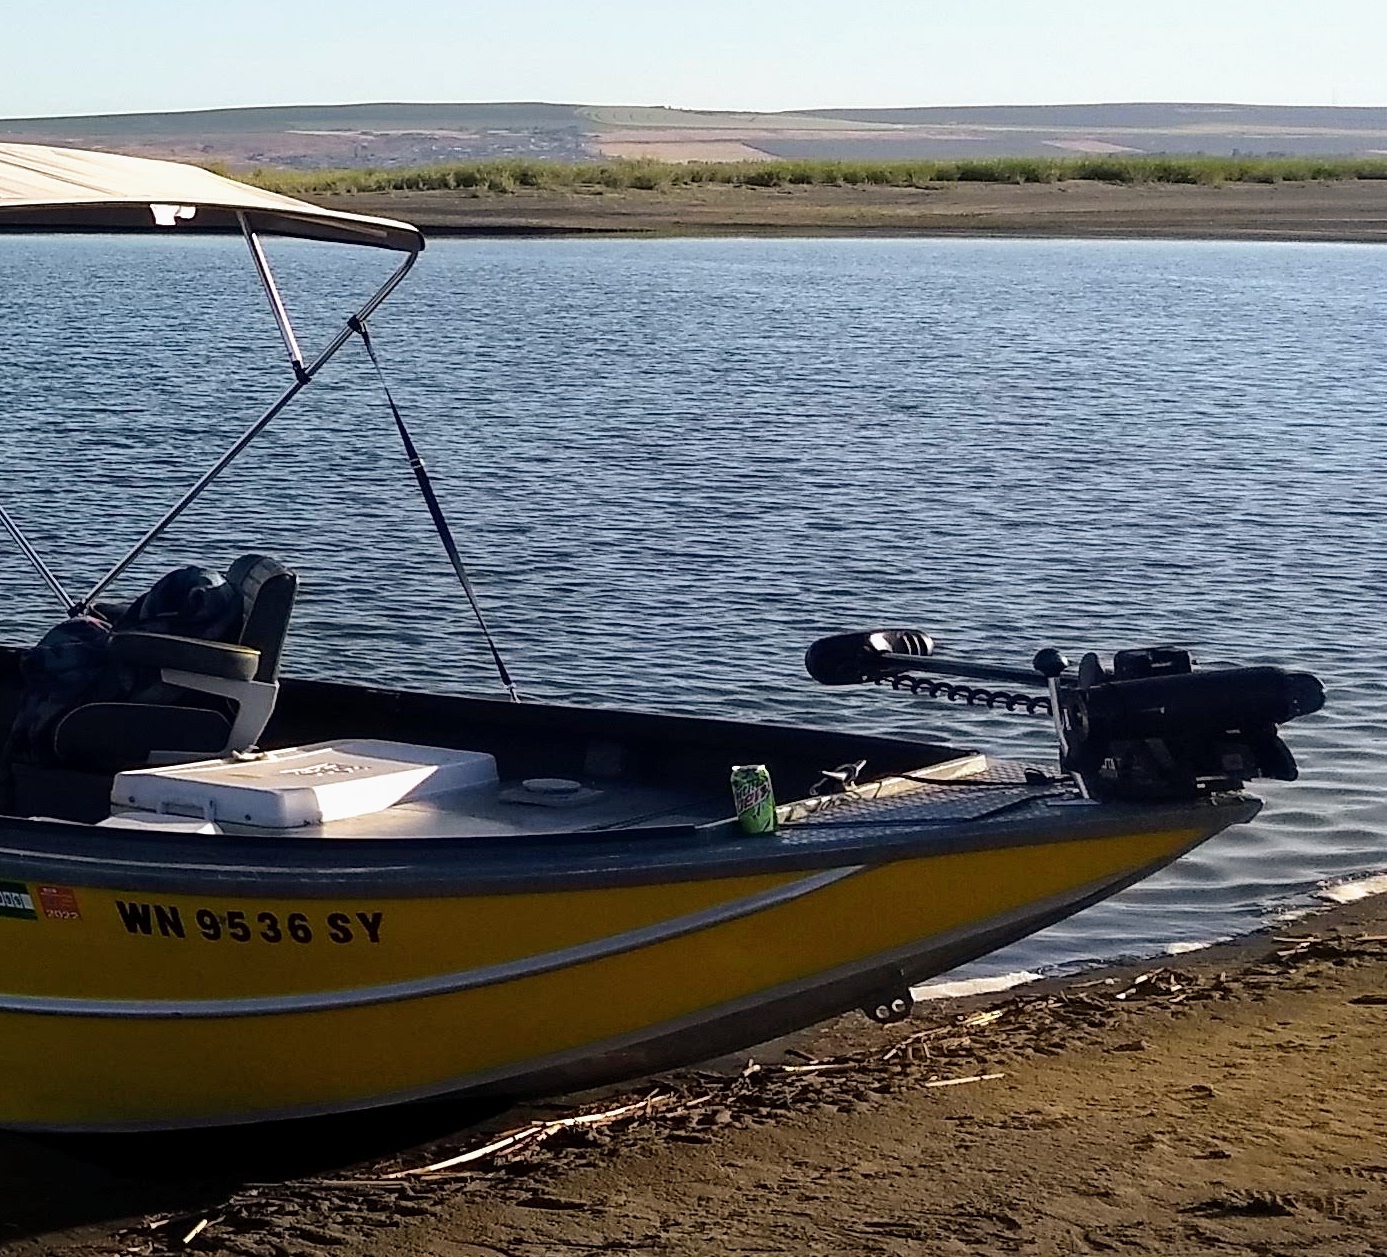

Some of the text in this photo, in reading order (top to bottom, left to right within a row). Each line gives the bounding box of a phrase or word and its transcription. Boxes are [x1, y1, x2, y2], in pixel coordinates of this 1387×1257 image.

[116, 901, 383, 943] WN 9536 SY
